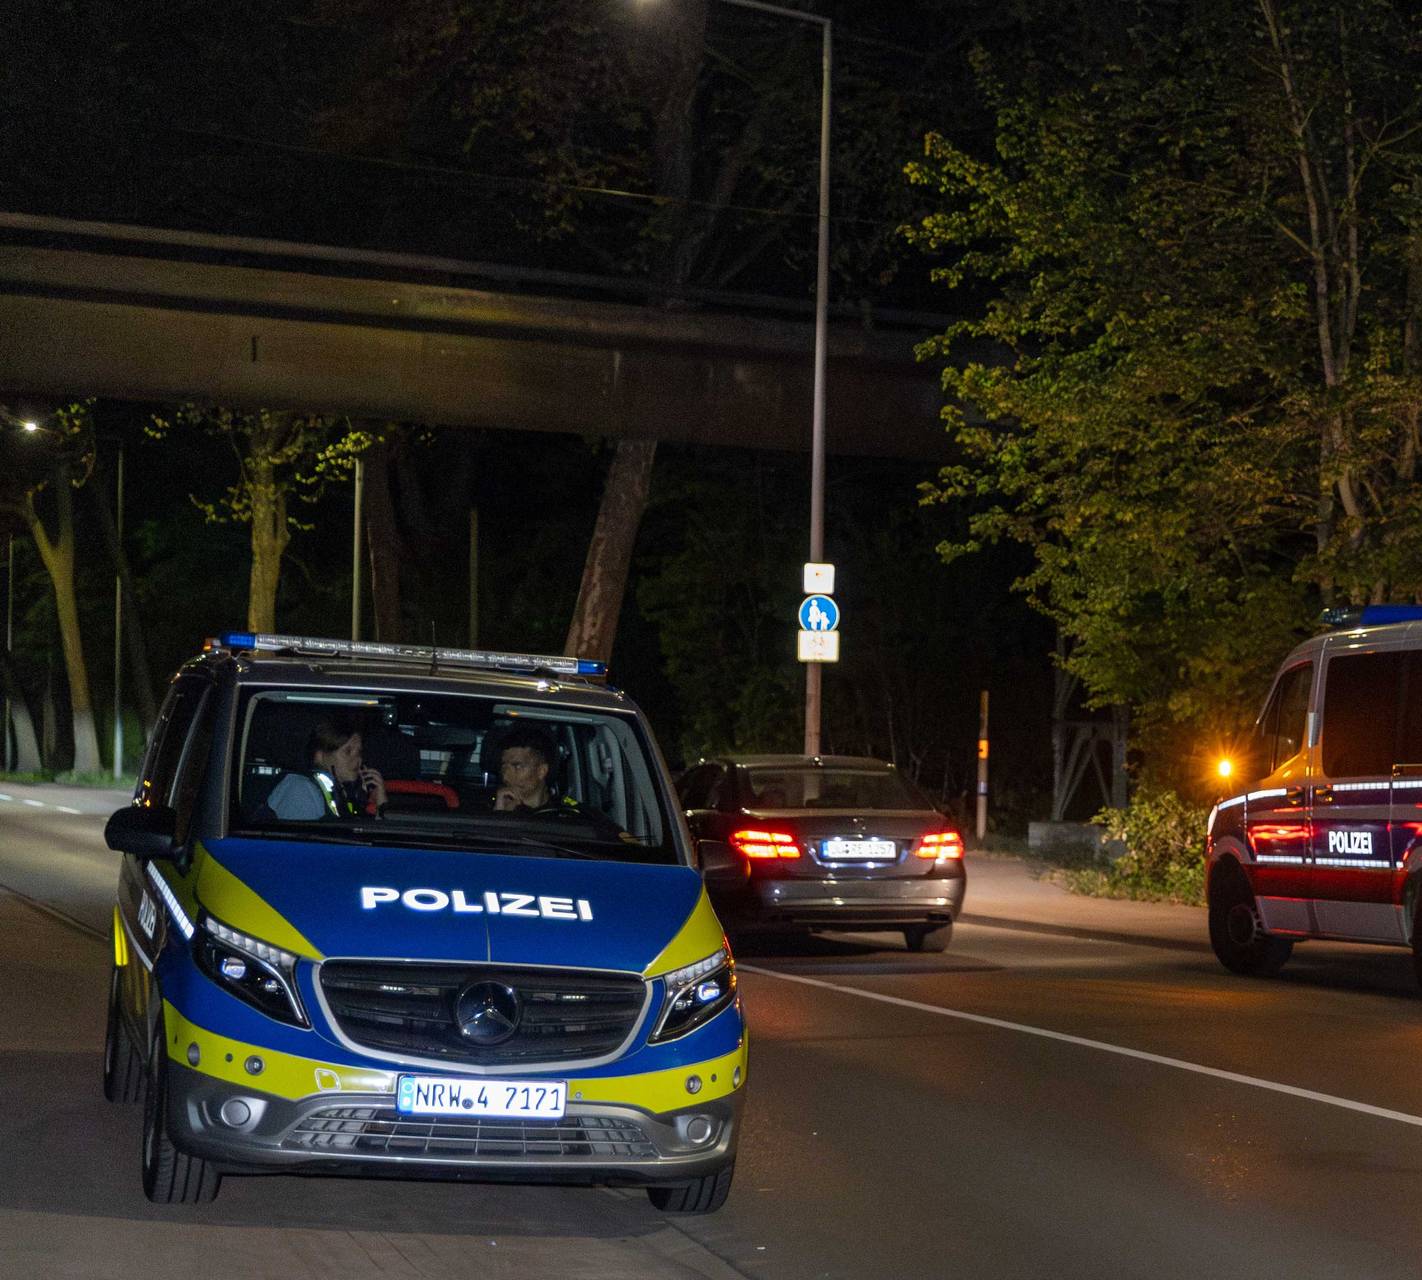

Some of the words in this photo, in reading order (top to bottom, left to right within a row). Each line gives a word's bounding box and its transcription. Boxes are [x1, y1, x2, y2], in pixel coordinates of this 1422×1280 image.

[1328, 831, 1373, 855] POLIZEI
[361, 887, 594, 921] POLIZEI
[415, 1083, 462, 1107] NRW
[477, 1086, 489, 1109] 4
[505, 1087, 560, 1110] 7171
